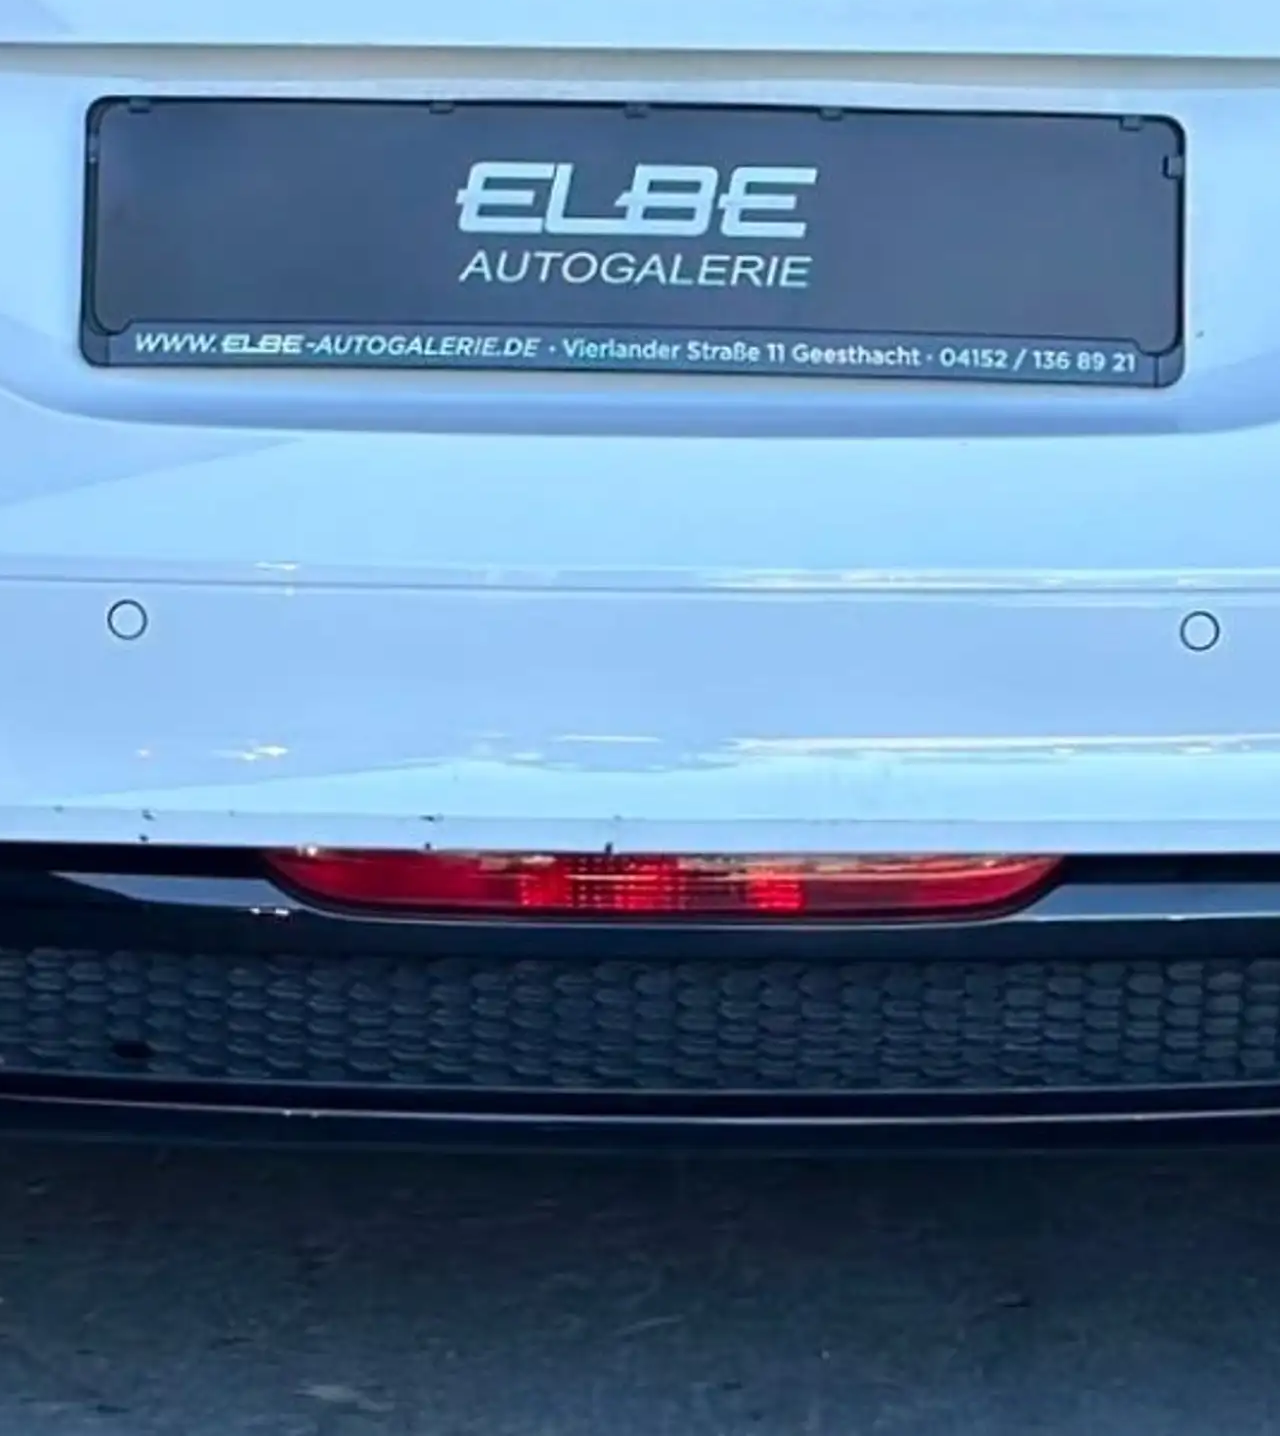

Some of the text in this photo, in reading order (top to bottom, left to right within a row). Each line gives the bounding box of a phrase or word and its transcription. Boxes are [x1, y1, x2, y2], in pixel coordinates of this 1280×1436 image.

[456, 162, 817, 238] ELBE
[459, 250, 812, 288] AUTOGALERIE
[135, 332, 541, 358] WWW.ELBE-AUTOGALERIE.DE
[562, 337, 681, 361] Vierlander
[687, 340, 760, 363] Straße
[767, 343, 785, 364] 11
[792, 343, 921, 366] Geesthacht
[939, 347, 1008, 369] 04152
[1033, 349, 1070, 370] 136
[1077, 351, 1105, 372] 89
[1111, 352, 1135, 373] 21
